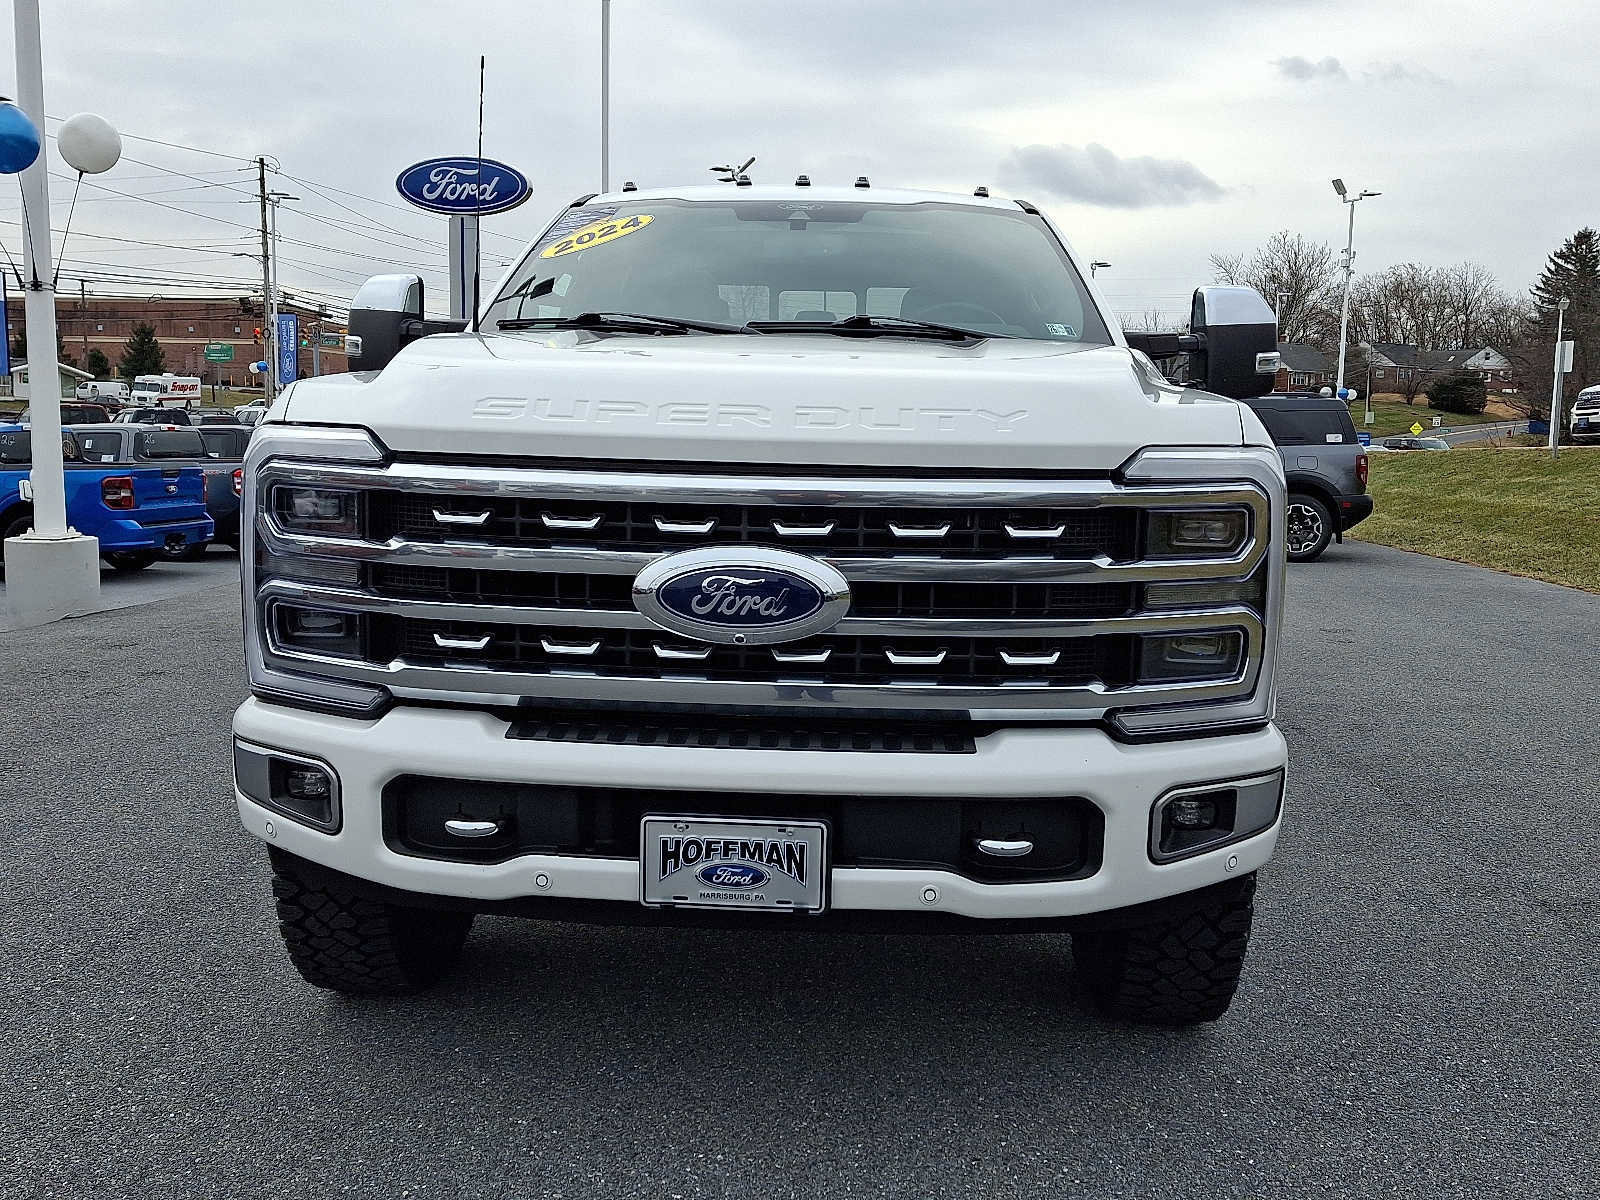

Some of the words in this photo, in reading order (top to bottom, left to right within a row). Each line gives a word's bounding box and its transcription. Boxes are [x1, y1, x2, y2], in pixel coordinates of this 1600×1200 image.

[422, 166, 500, 201] Ford
[553, 216, 643, 255] 2024
[171, 382, 198, 393] Snap-on
[471, 396, 772, 429] SUPER
[793, 405, 1030, 433] DUTY
[691, 574, 788, 617] Ford
[659, 834, 808, 888] HOFFMAN
[712, 866, 754, 888] Ford
[699, 891, 753, 902] HARRISBURG,
[754, 892, 766, 902] PA
